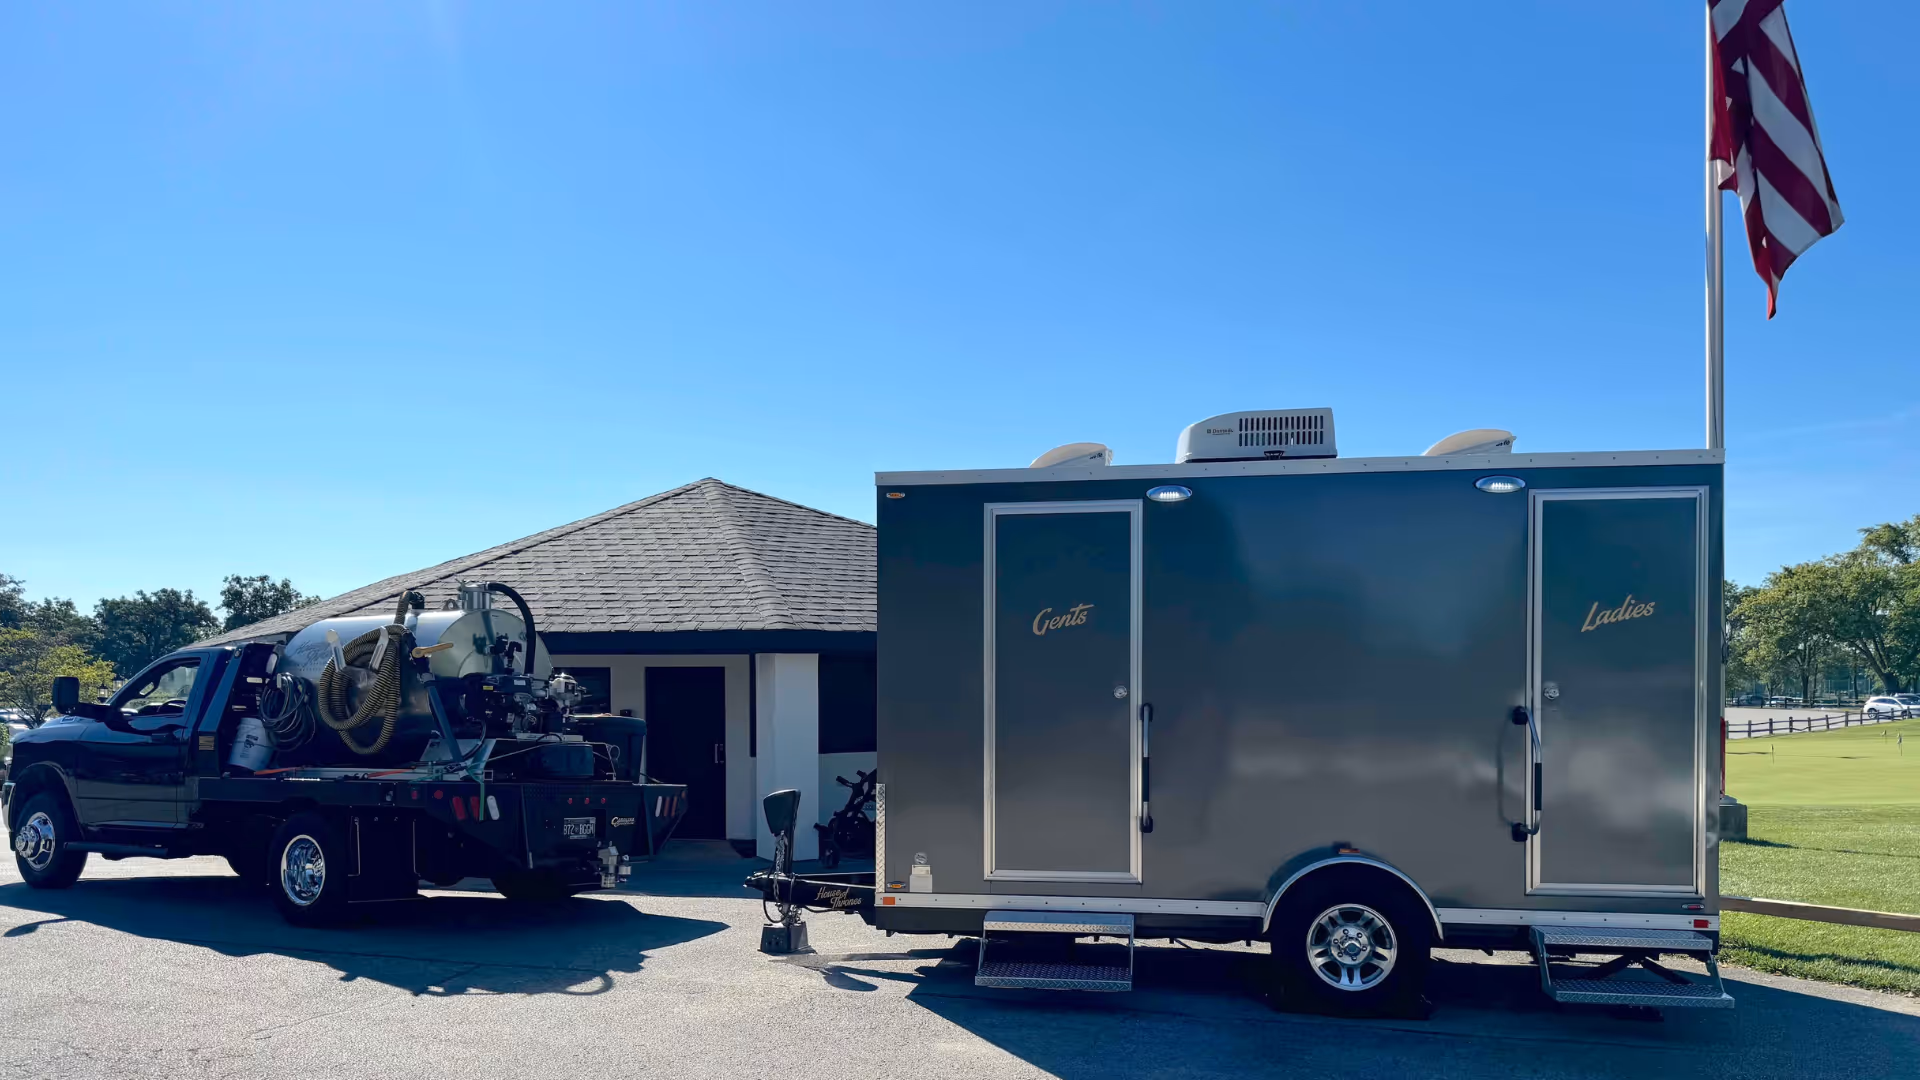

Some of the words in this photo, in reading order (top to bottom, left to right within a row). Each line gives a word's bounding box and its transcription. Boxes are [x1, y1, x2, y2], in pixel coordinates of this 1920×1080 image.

[1032, 603, 1094, 636] Gents
[1580, 594, 1656, 633] Ladies
[814, 886, 841, 901] House
[830, 897, 863, 910] Thrones
